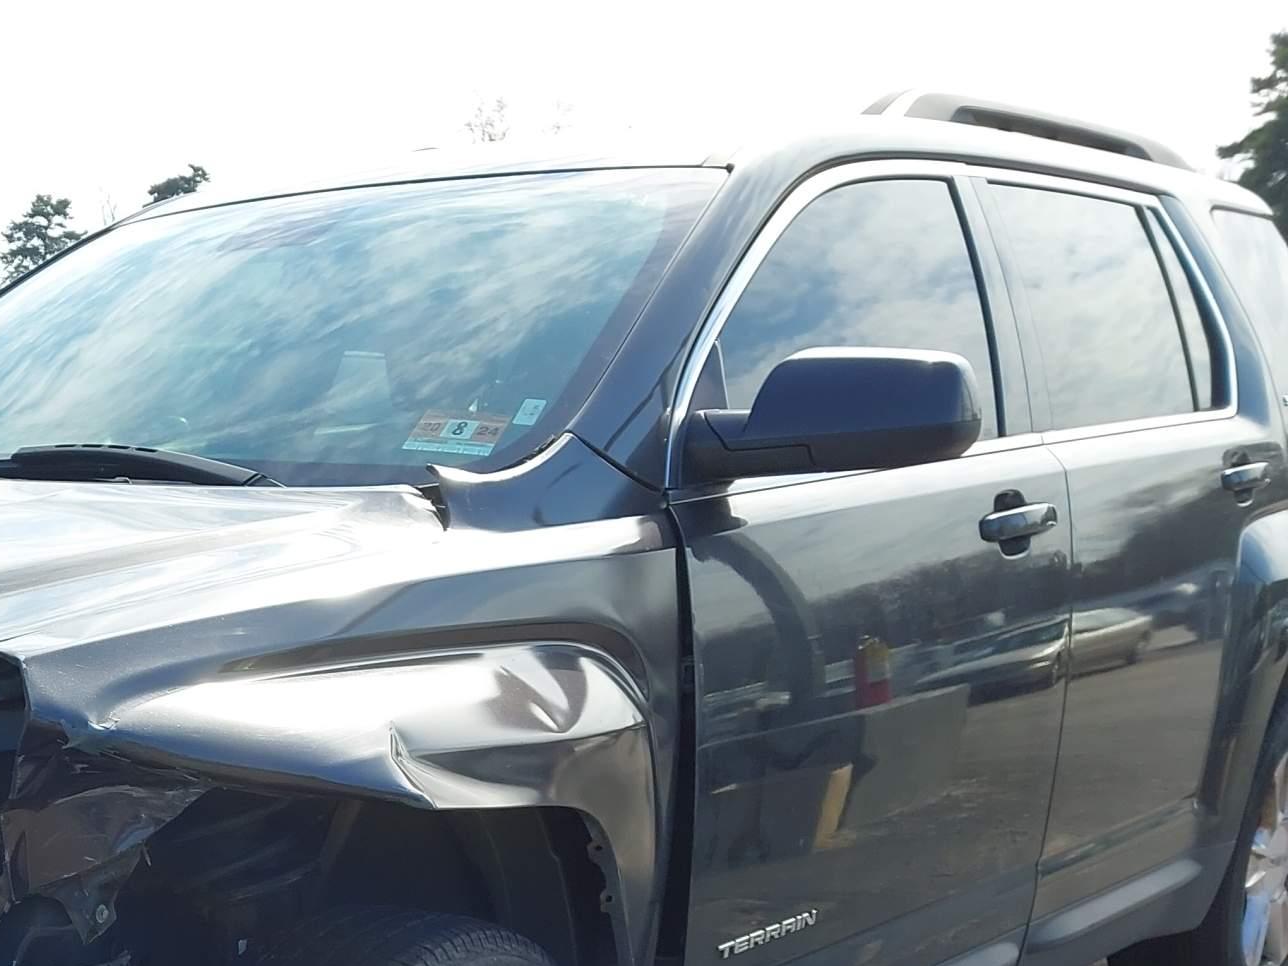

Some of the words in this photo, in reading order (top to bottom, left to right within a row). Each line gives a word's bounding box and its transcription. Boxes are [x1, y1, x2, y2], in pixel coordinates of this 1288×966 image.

[452, 421, 468, 436] 8
[476, 427, 499, 436] 24
[717, 909, 818, 959] TERRAIN
